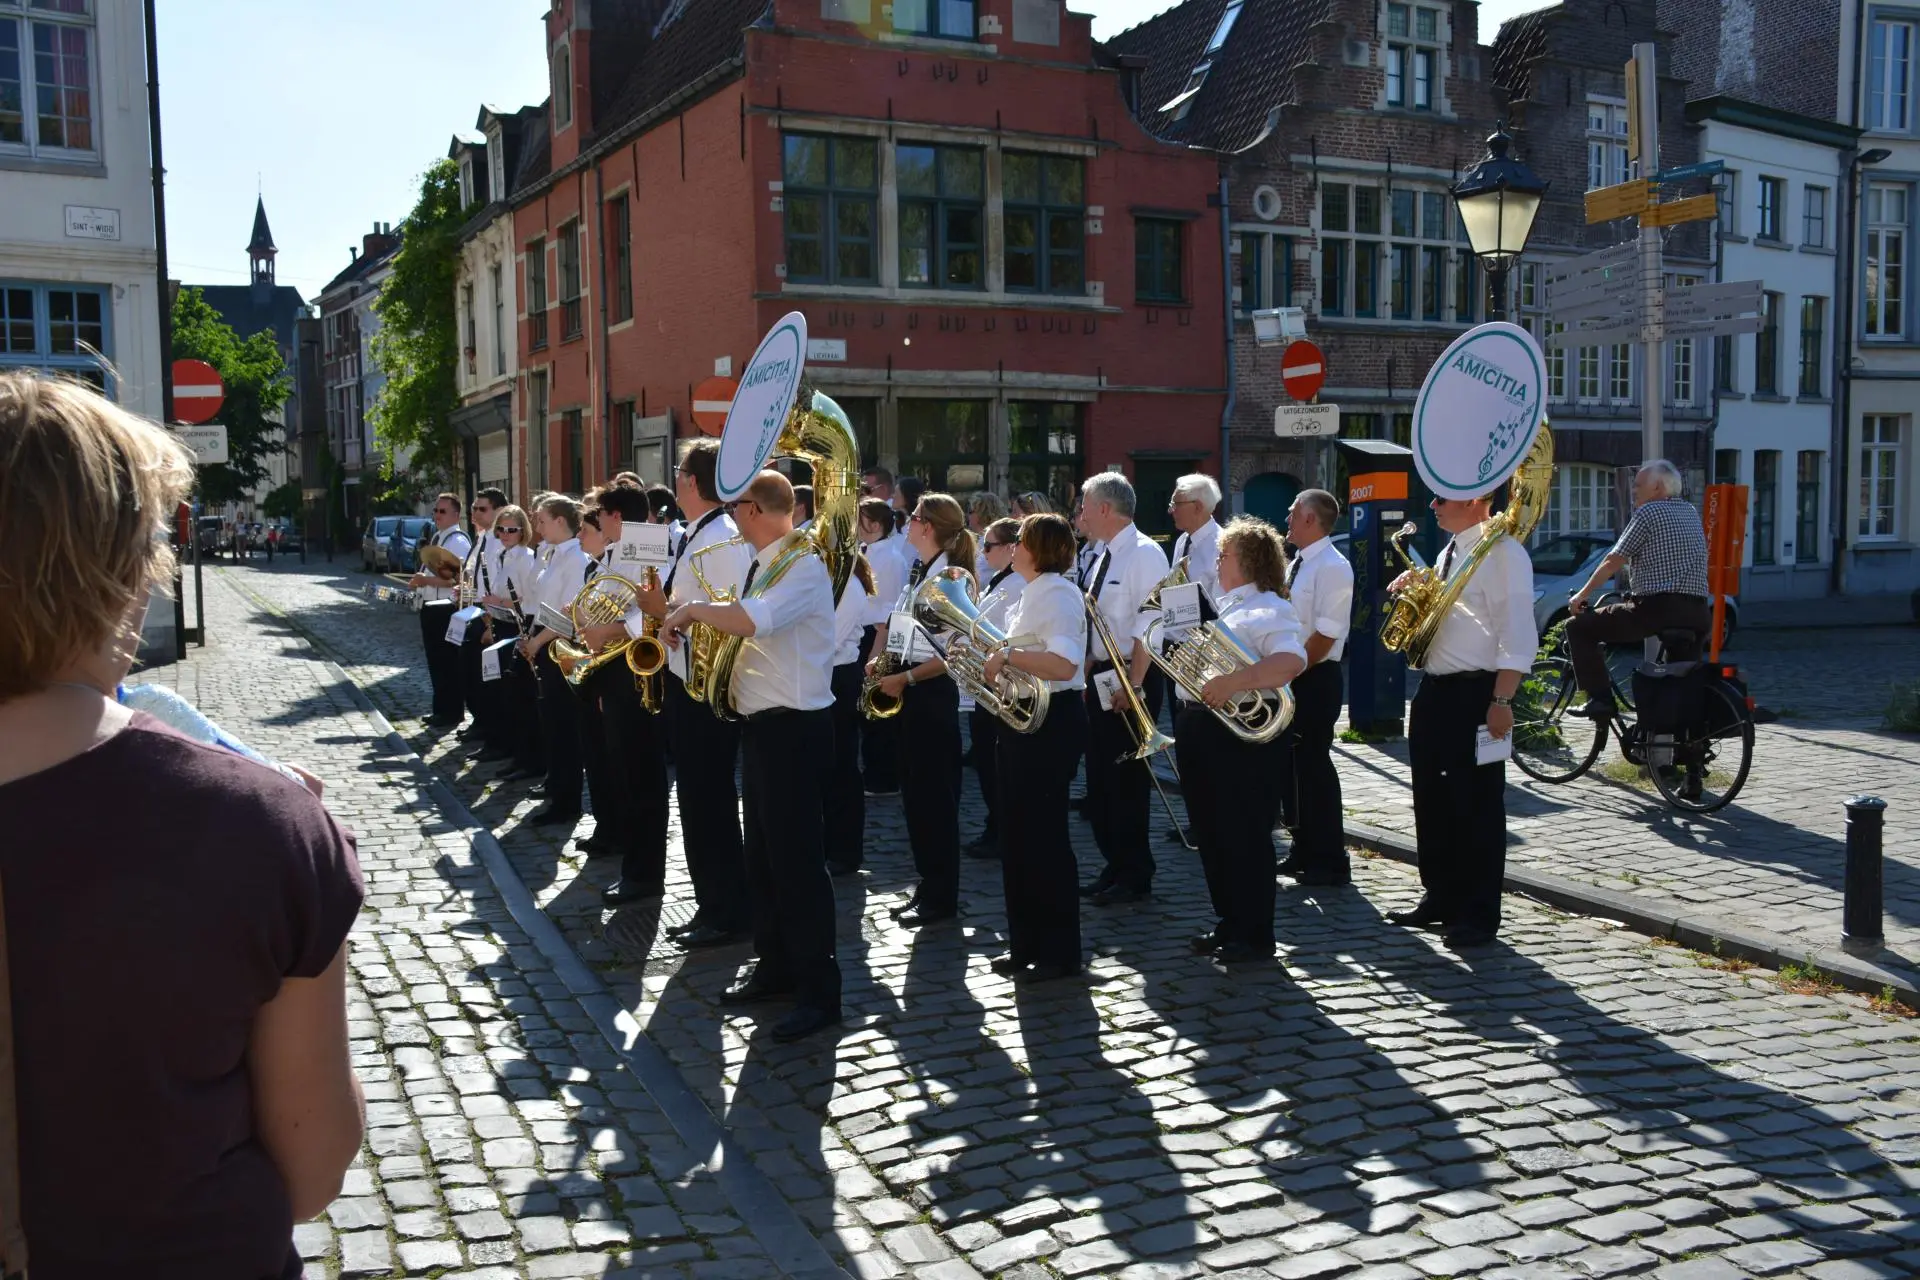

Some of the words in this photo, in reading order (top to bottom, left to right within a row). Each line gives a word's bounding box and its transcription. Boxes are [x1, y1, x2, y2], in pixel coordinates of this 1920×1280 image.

[745, 358, 791, 388] AMICITIA
[1452, 355, 1527, 401] AMICITIA
[1283, 406, 1330, 415] UITGEZONDERD
[1350, 485, 1374, 500] 2007
[1353, 506, 1365, 529] P
